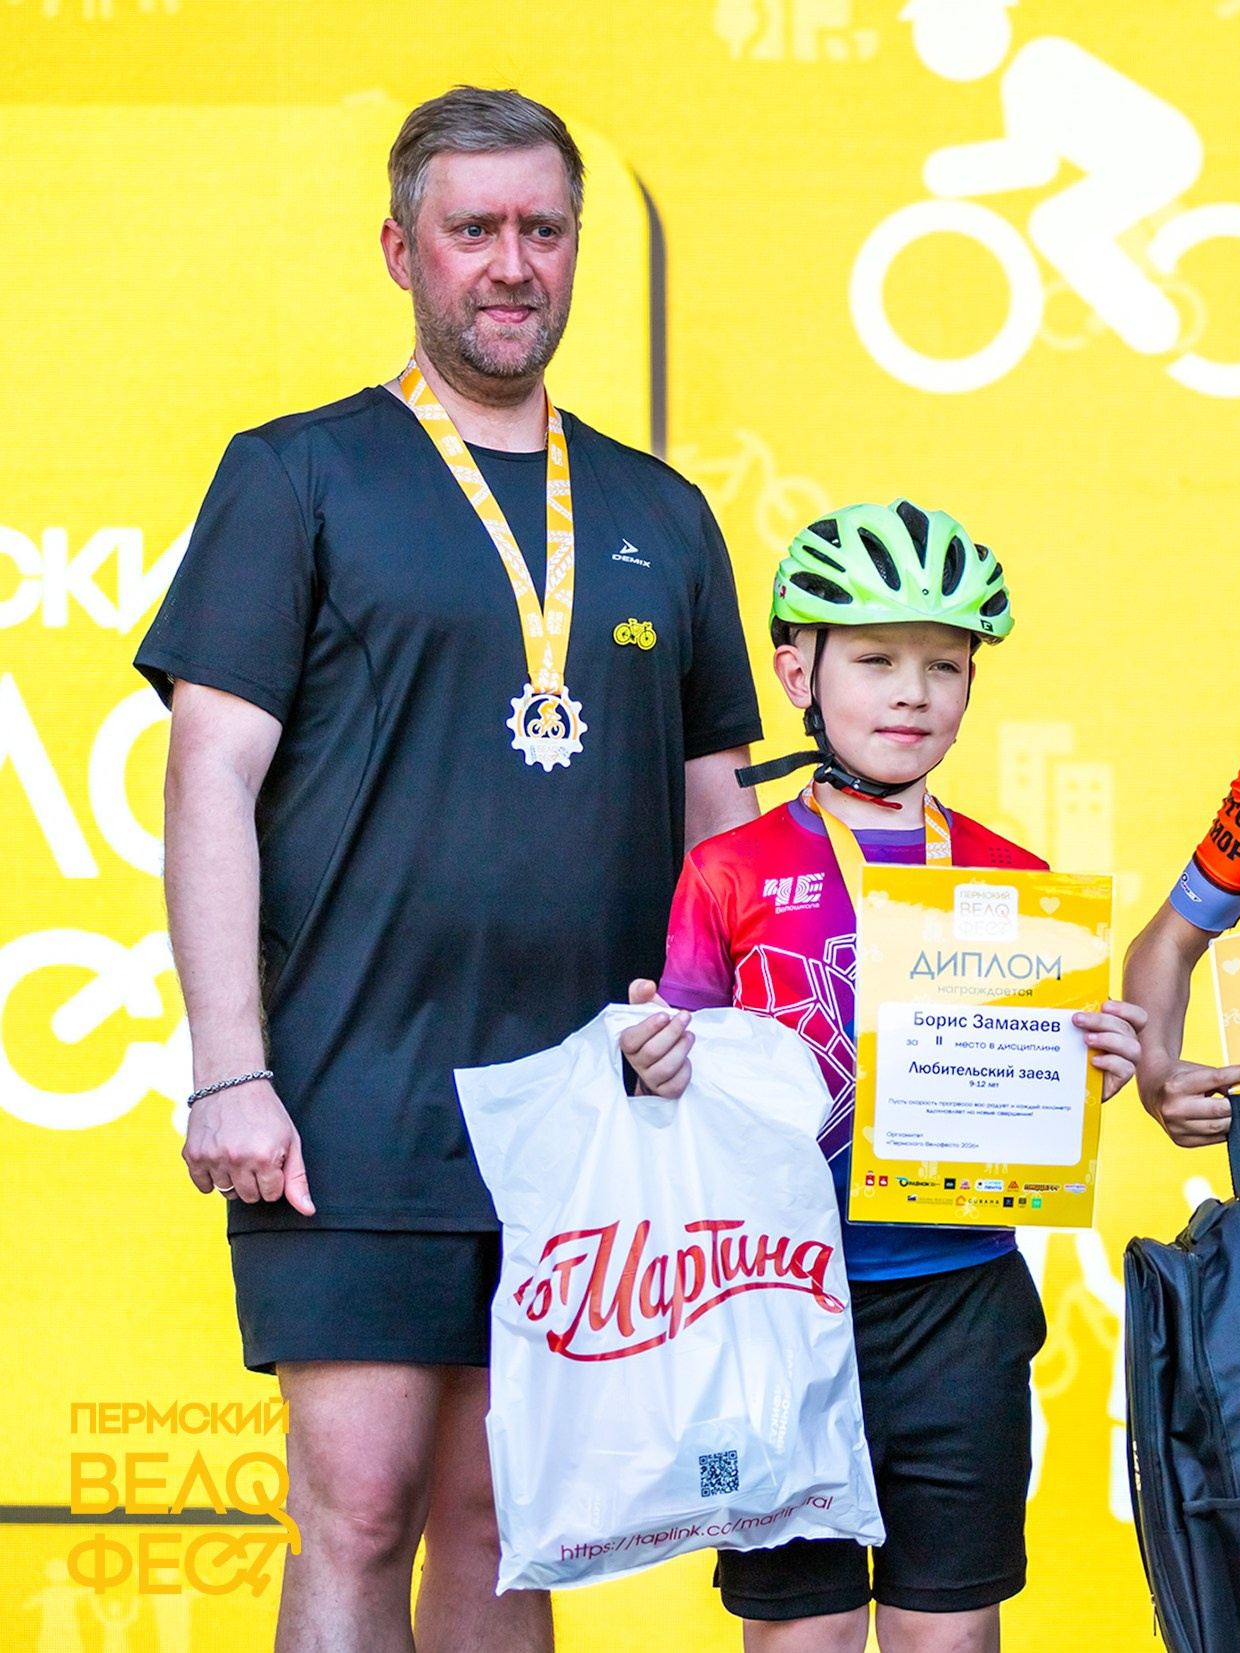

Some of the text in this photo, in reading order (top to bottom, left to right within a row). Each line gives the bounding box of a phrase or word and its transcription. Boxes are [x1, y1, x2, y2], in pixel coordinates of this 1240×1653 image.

[611, 553, 651, 569] DEMIX
[909, 950, 1062, 981] ДИПЛОМ
[937, 984, 1033, 998] награждается
[914, 1011, 1061, 1033] Борис Замахаев
[936, 1036, 943, 1045] II
[955, 1041, 986, 1049] место
[997, 1043, 1061, 1052] дисциплине
[909, 1061, 1060, 1081] Любительский заезд
[969, 1080, 986, 1088] 9-12
